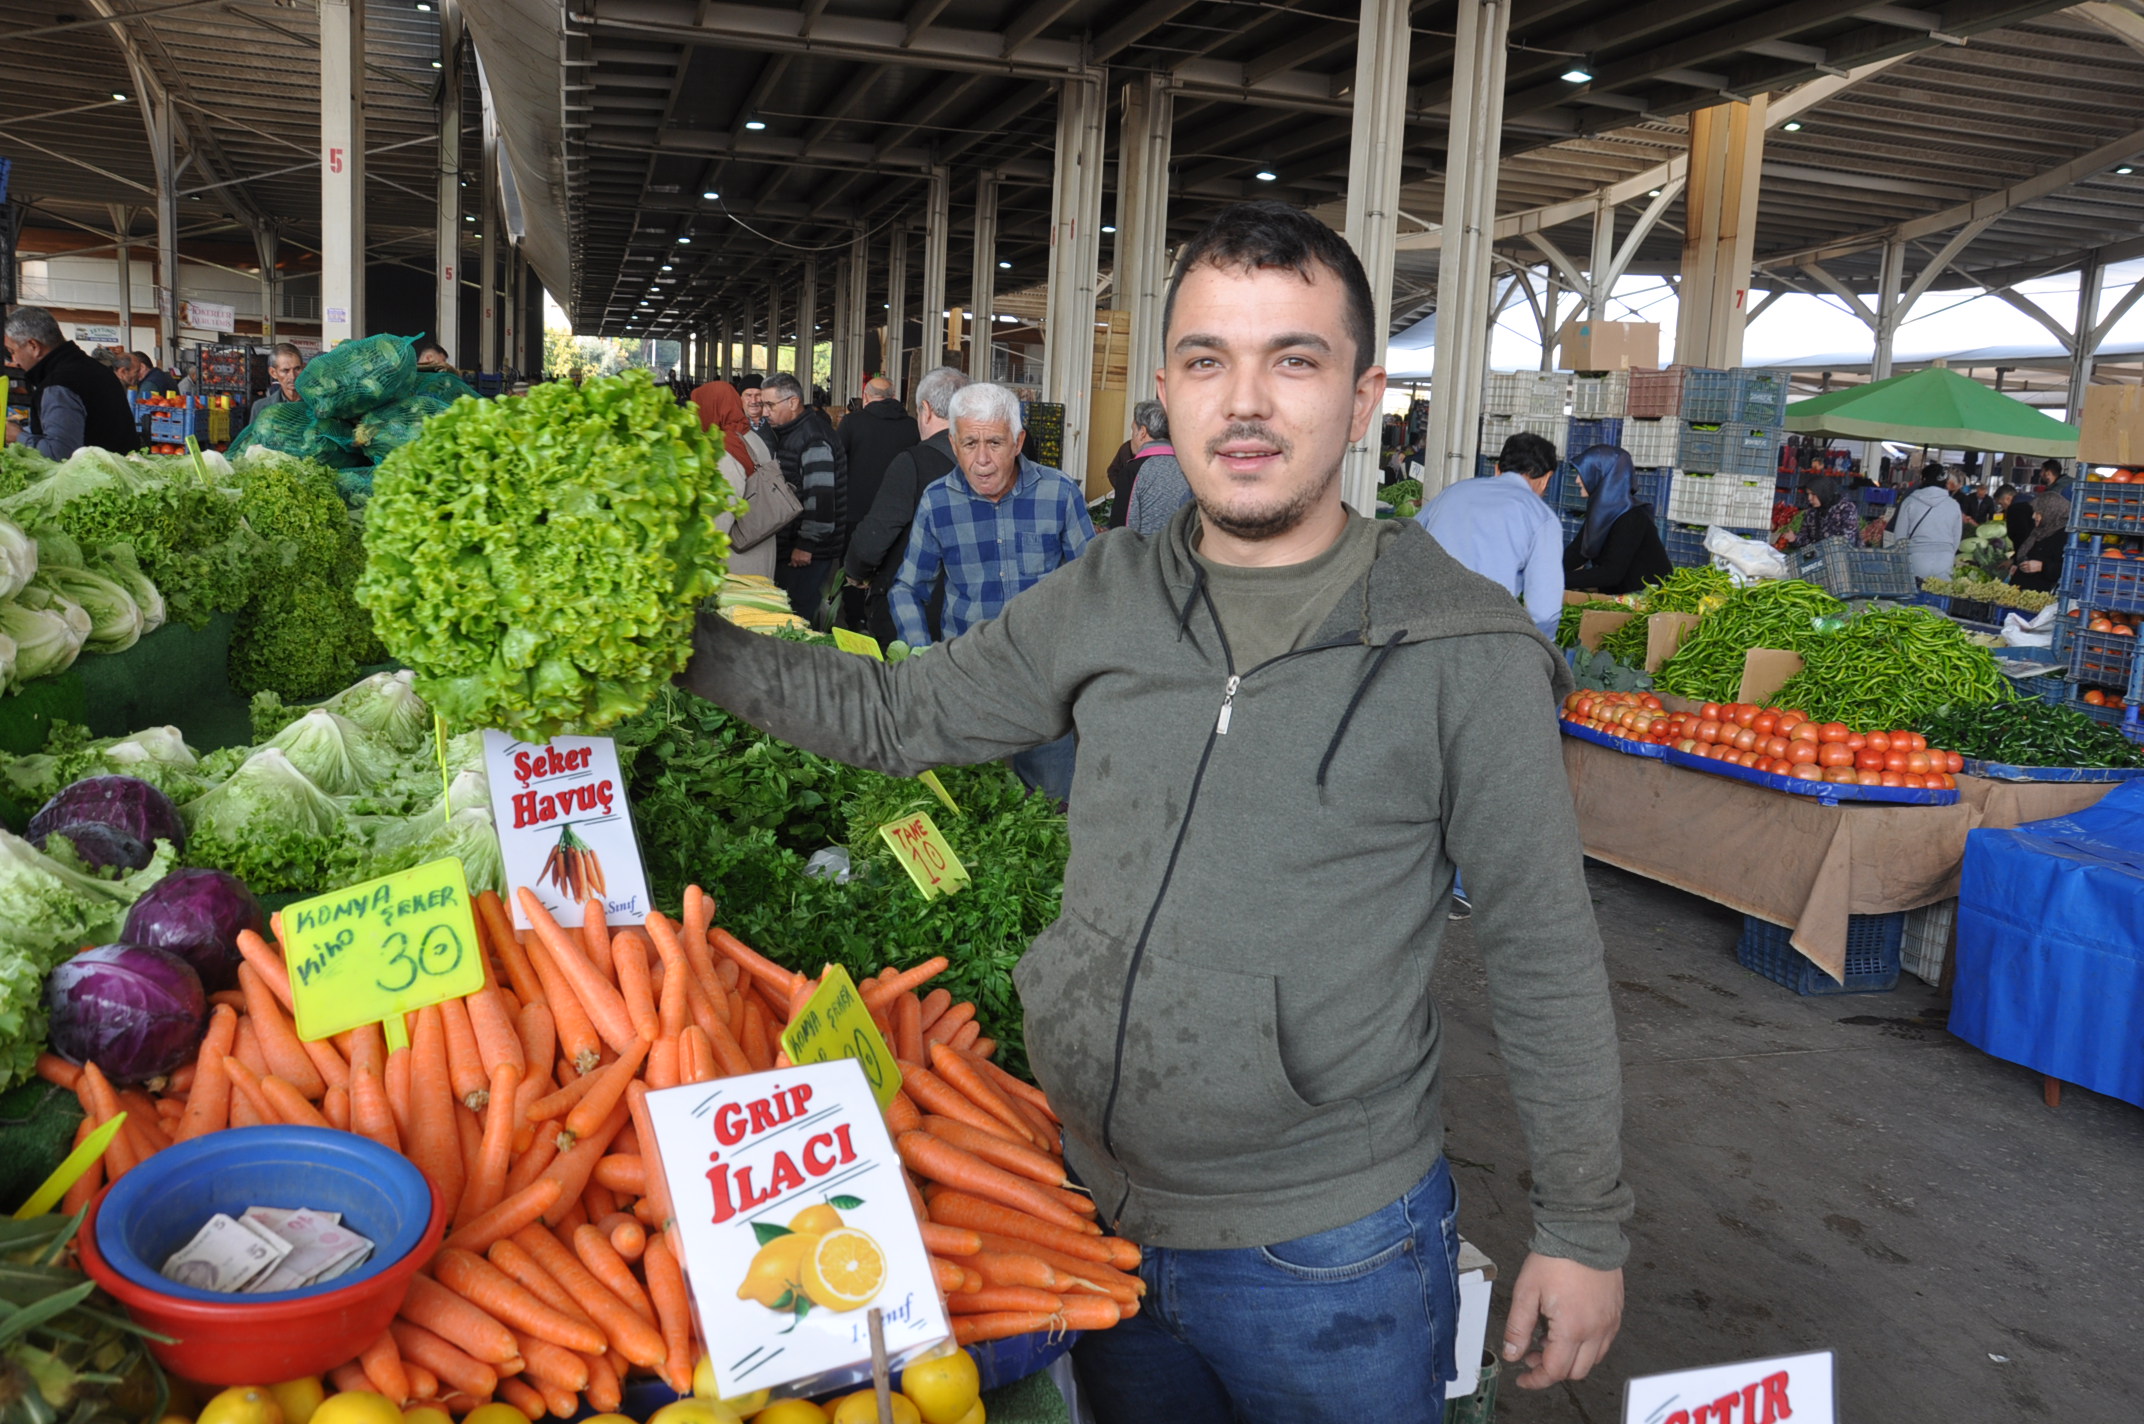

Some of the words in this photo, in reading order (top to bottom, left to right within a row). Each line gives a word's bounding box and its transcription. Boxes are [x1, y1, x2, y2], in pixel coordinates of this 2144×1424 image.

[329, 147, 343, 174] 5
[445, 267, 453, 280] 5
[1736, 289, 1745, 309] 7
[513, 745, 593, 789] Şeker
[511, 779, 613, 829] Havuç
[912, 840, 946, 885] 10
[296, 883, 392, 934] KONYA
[379, 885, 459, 928] ŞEKER
[376, 924, 463, 993] 30
[713, 1083, 814, 1147] GRİP
[704, 1123, 858, 1225] İLACI
